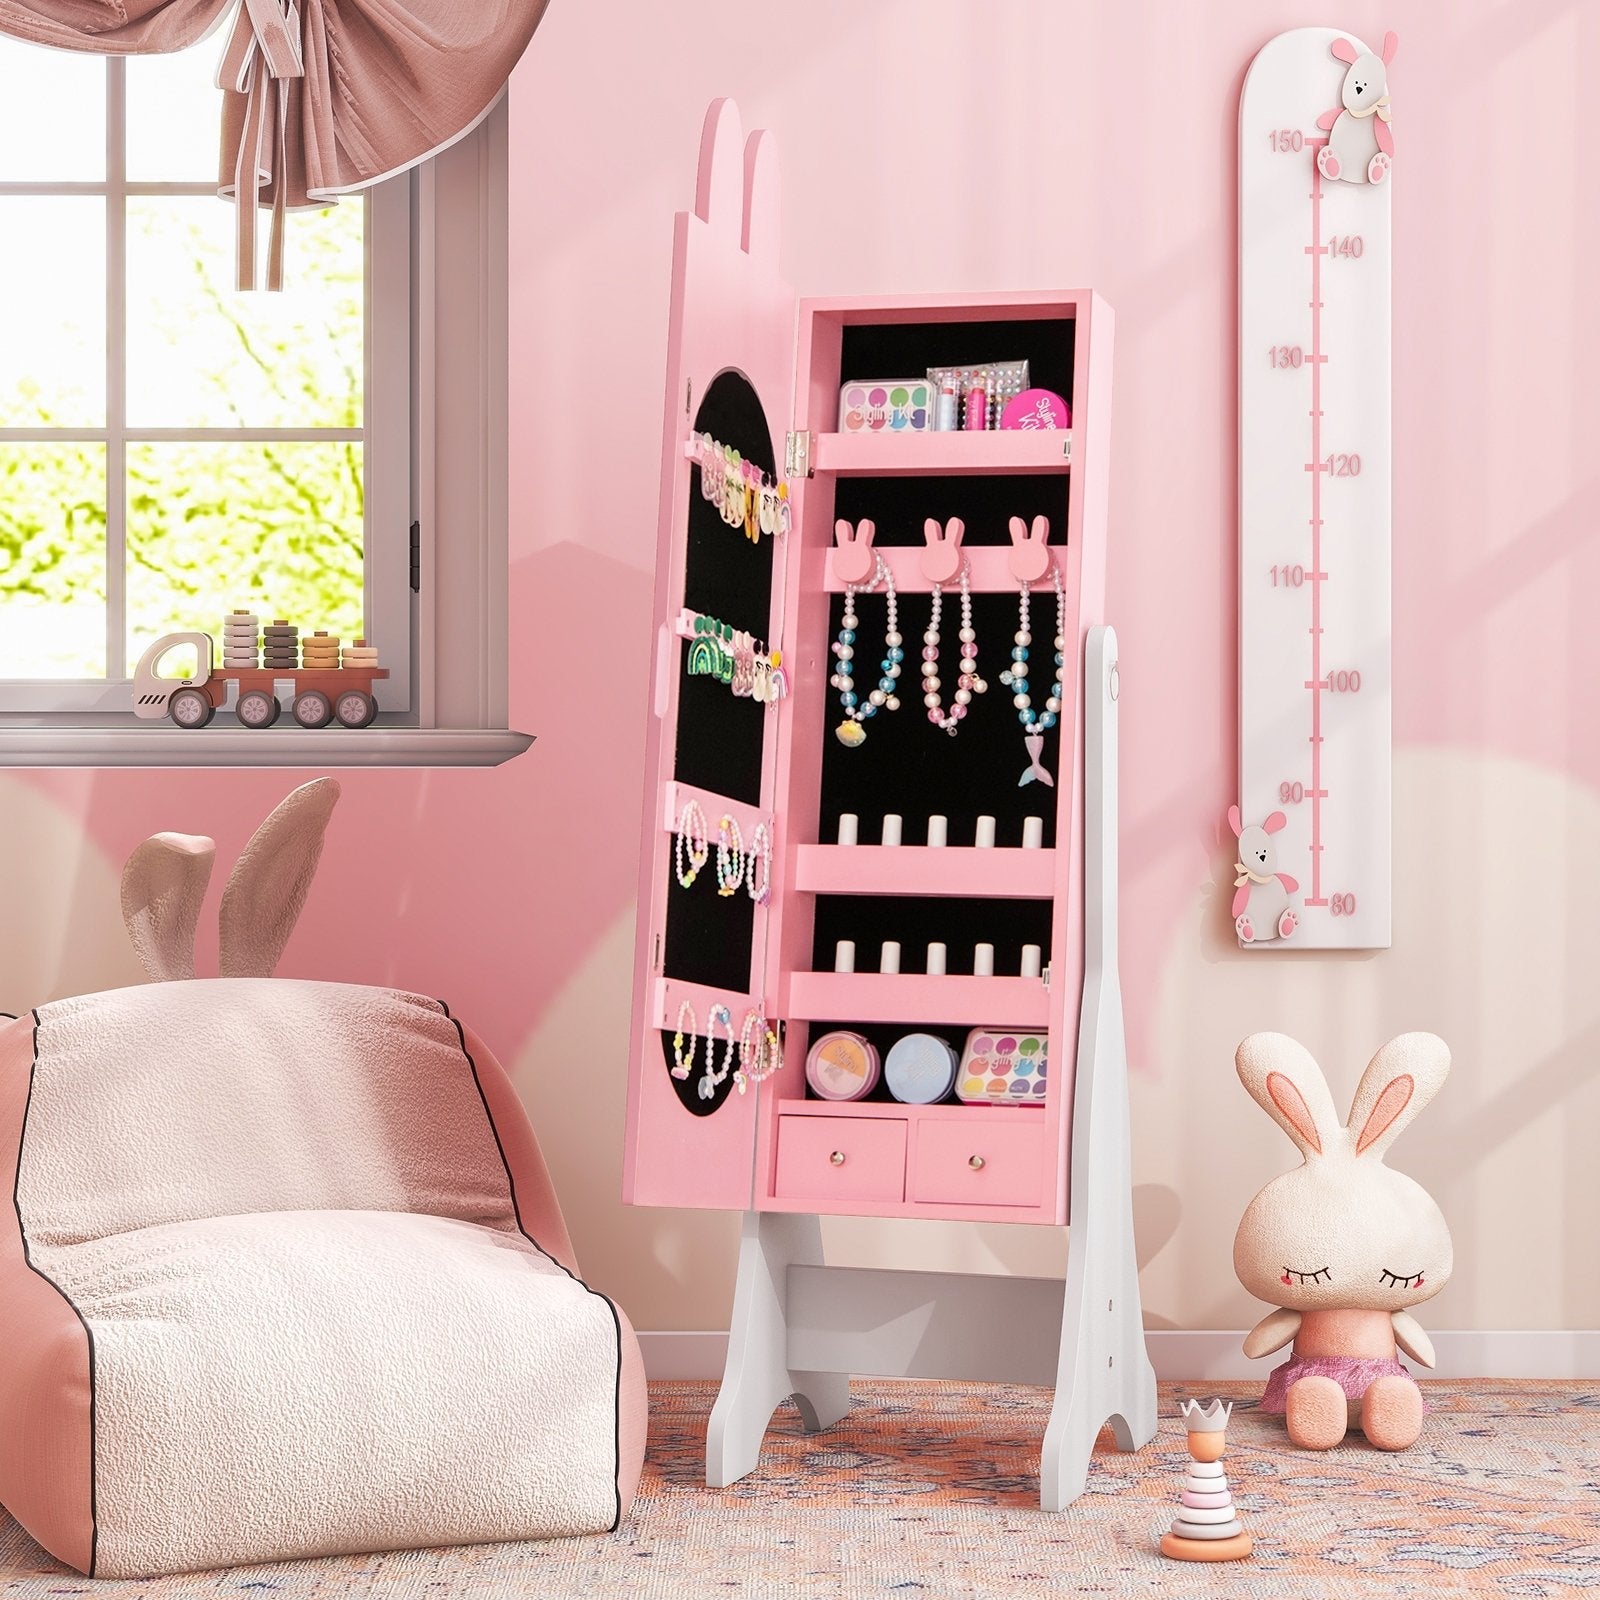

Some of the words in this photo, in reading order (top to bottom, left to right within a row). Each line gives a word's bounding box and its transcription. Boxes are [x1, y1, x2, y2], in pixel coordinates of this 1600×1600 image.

[1269, 129, 1304, 152] 150
[1329, 235, 1364, 259] 140
[1269, 345, 1303, 369] 130
[1327, 453, 1362, 477] 120
[1269, 564, 1304, 588] 110
[1327, 670, 1361, 693] 100
[1279, 781, 1304, 805] 90
[1330, 892, 1356, 916] 80
